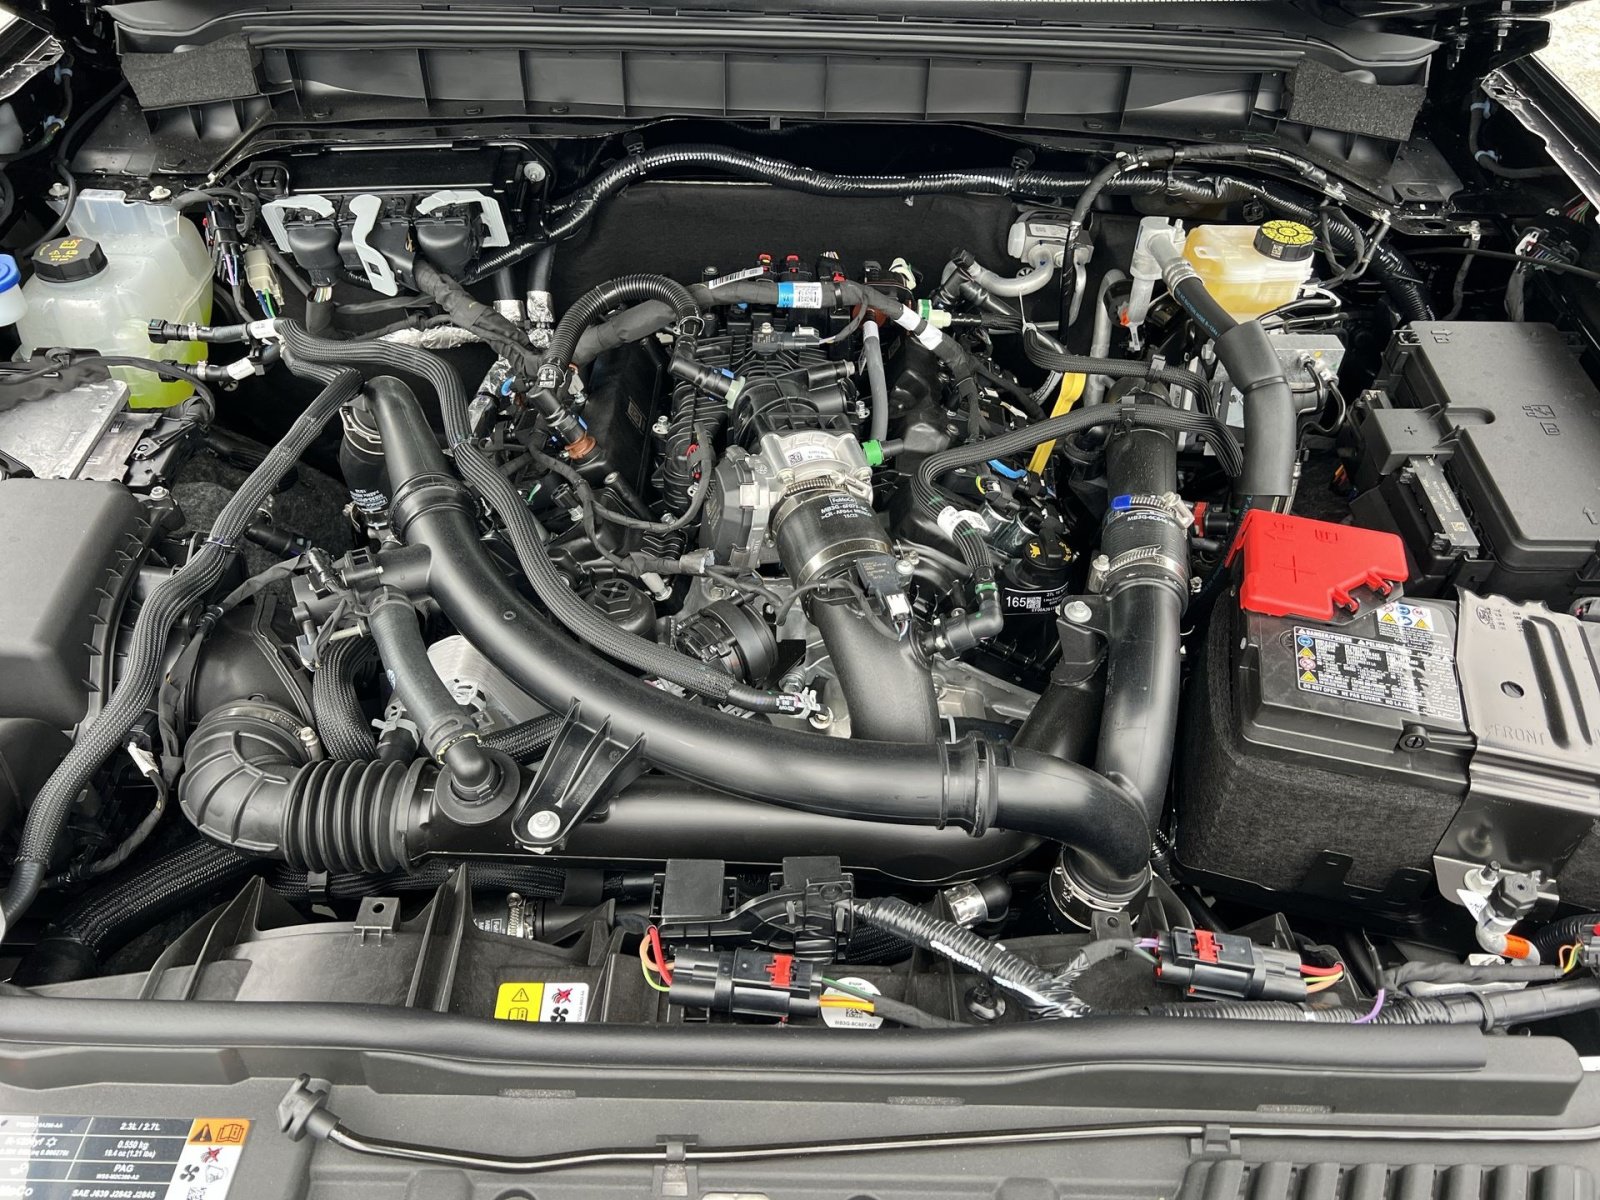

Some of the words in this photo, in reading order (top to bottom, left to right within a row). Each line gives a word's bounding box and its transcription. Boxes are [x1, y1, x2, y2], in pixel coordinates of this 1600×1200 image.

[1006, 596, 1026, 608] 165
[1494, 724, 1544, 745] FRONT
[120, 1122, 137, 1130] 2.3L
[142, 1122, 160, 1131] 2.7L
[117, 1140, 138, 1149] 0.550
[139, 1141, 150, 1150] kg
[114, 1164, 135, 1172] PAG
[72, 1189, 90, 1197] SAE
